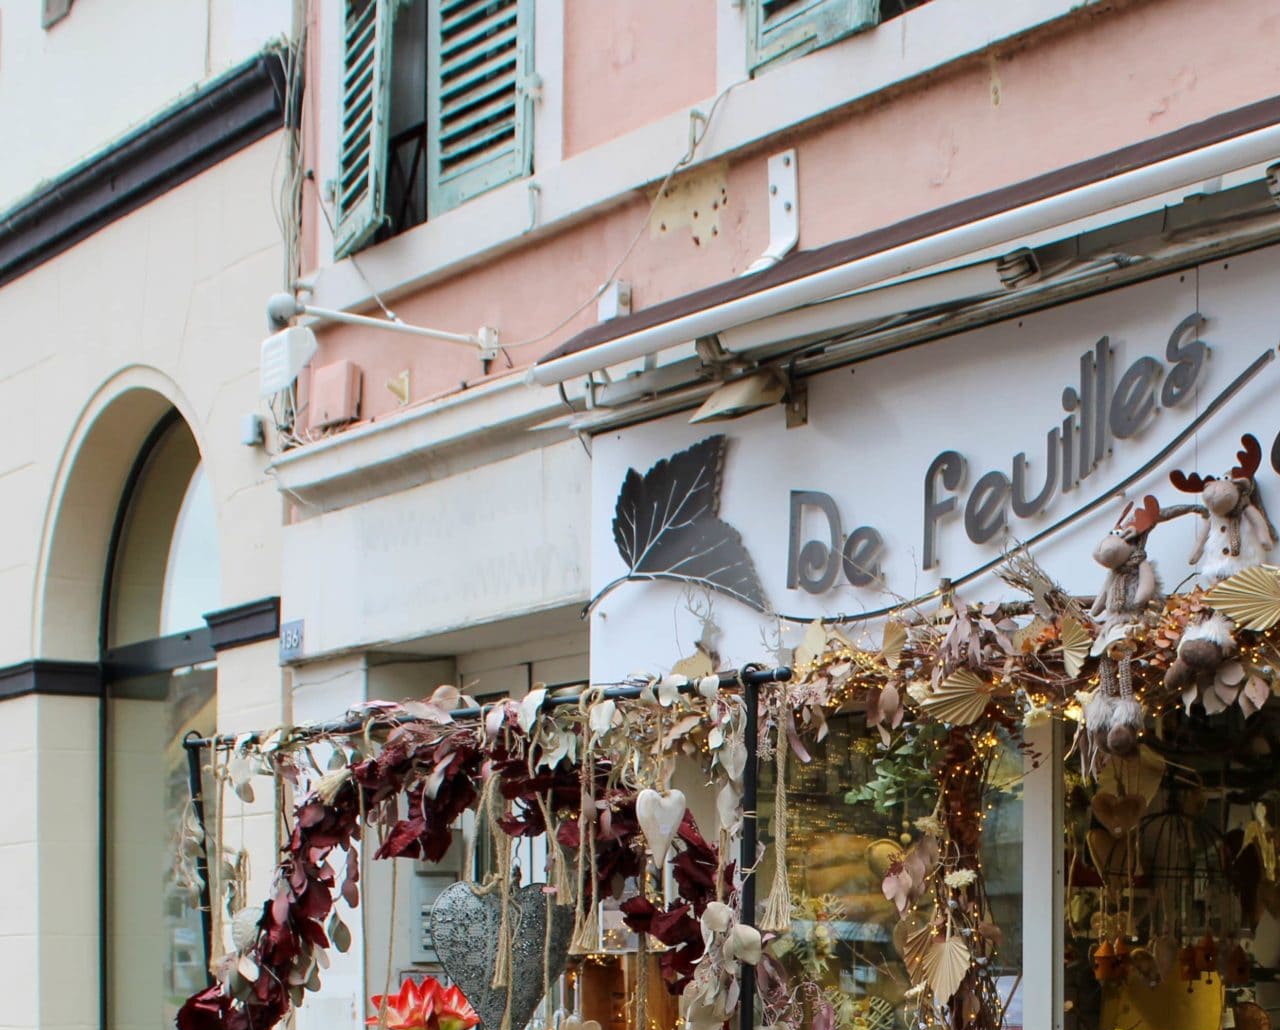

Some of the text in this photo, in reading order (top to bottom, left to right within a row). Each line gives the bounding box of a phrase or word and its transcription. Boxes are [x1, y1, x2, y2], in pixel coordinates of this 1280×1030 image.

[787, 489, 884, 595] De
[922, 312, 1207, 571] feuilles
[282, 626, 299, 649] 136
